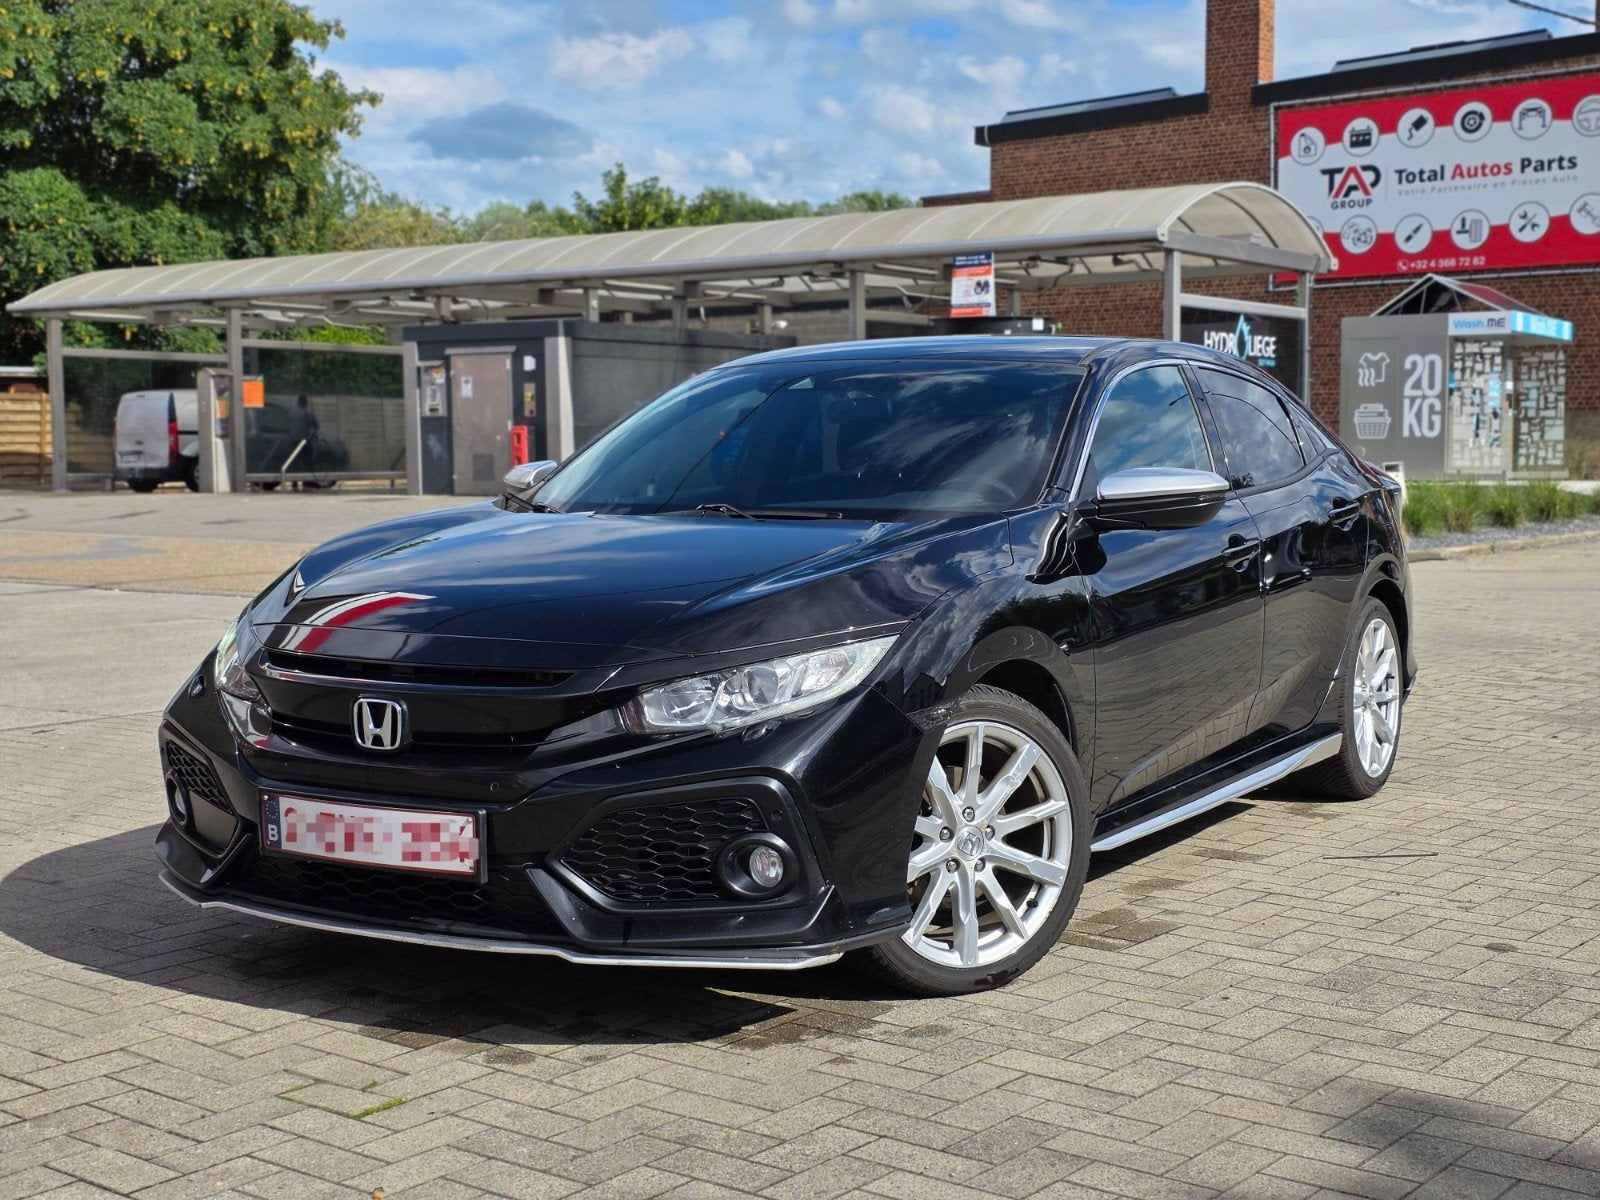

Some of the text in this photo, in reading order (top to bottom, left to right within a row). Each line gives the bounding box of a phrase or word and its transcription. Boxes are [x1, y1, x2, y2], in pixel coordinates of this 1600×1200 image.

[1394, 154, 1578, 185] Total Autos Parts
[1319, 164, 1382, 199] TAP
[1396, 187, 1426, 196] Votre
[1430, 182, 1488, 194] Partenaire
[1552, 174, 1579, 183] Auto
[1330, 198, 1373, 210] GROUP
[1429, 259, 1436, 268] 4
[1458, 257, 1471, 266] 72
[1453, 318, 1484, 329] Wash
[1403, 353, 1442, 398] 20
[1402, 398, 1442, 438] KG
[268, 824, 279, 842] B
